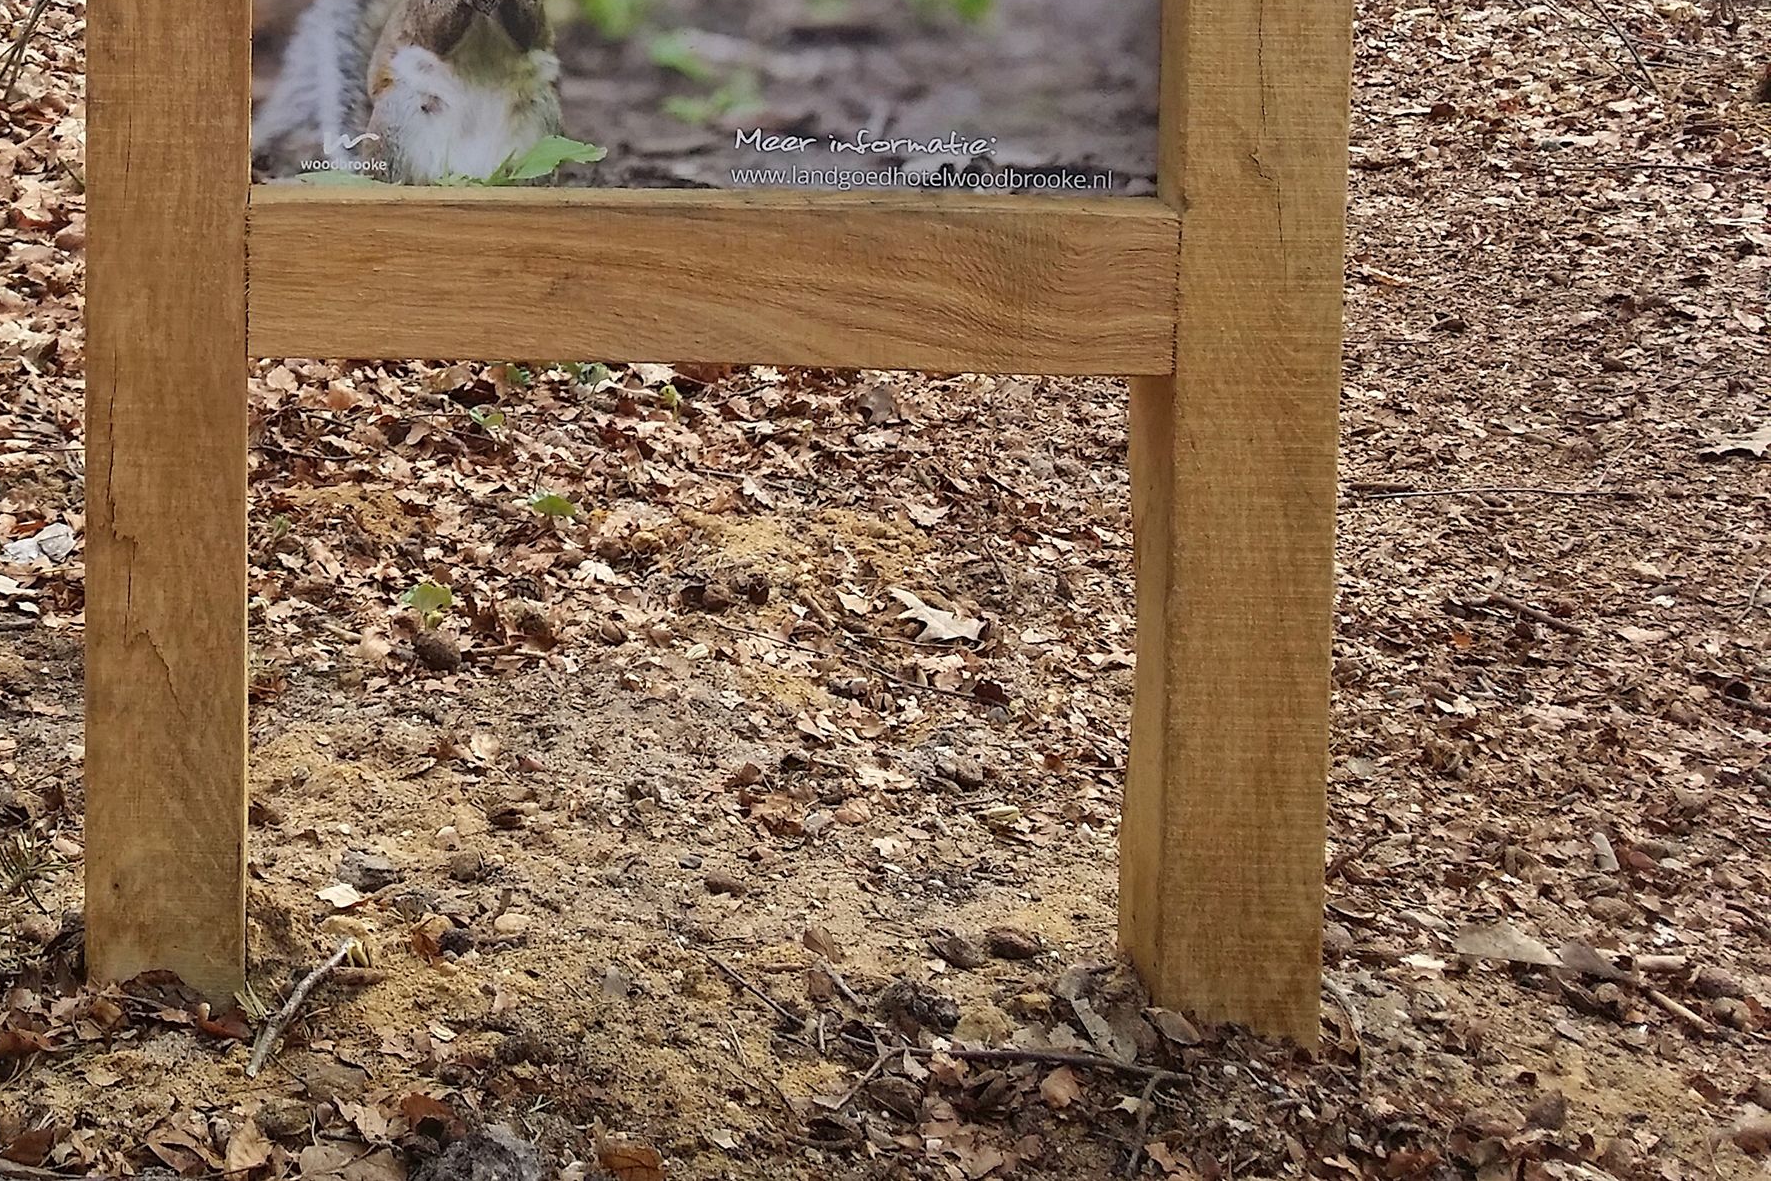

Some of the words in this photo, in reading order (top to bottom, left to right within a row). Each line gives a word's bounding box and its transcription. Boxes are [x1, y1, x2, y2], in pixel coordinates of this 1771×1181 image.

[734, 128, 818, 154] Meer
[828, 129, 998, 156] informatie:
[301, 158, 388, 171] woodbrooke
[730, 165, 1114, 191] www.landgoedhotelwoodbrooke.nl
